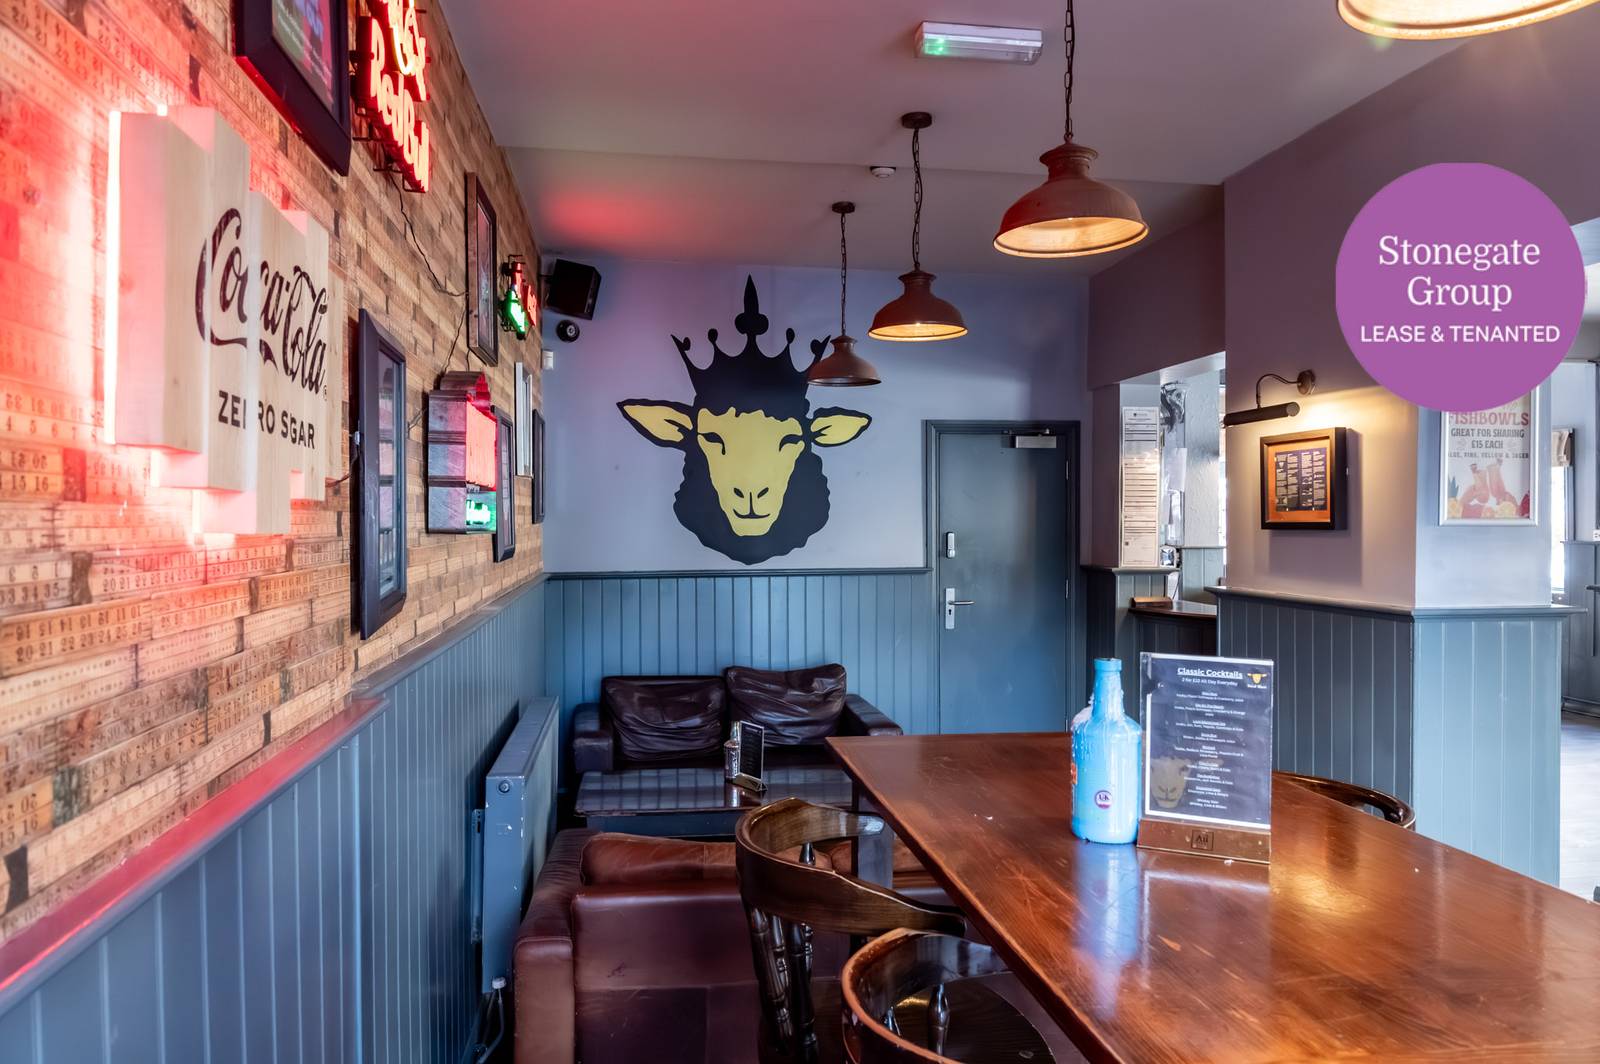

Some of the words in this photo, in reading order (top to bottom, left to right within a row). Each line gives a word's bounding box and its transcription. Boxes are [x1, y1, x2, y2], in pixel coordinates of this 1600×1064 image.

[1450, 428, 1475, 438] GREAT
[1477, 428, 1492, 438] FOR
[1493, 428, 1525, 439] SHARING
[1472, 440, 1484, 449] £15
[1485, 440, 1504, 449] EACH
[12, 474, 27, 491] 15
[36, 475, 49, 493] 16
[103, 578, 117, 592] 20
[119, 576, 130, 590] 21
[135, 574, 147, 587] 22
[16, 645, 34, 662] 20
[40, 640, 53, 657] 21
[61, 635, 75, 652] 22
[1177, 667, 1204, 677] Classic
[1205, 669, 1243, 680] Cocktails
